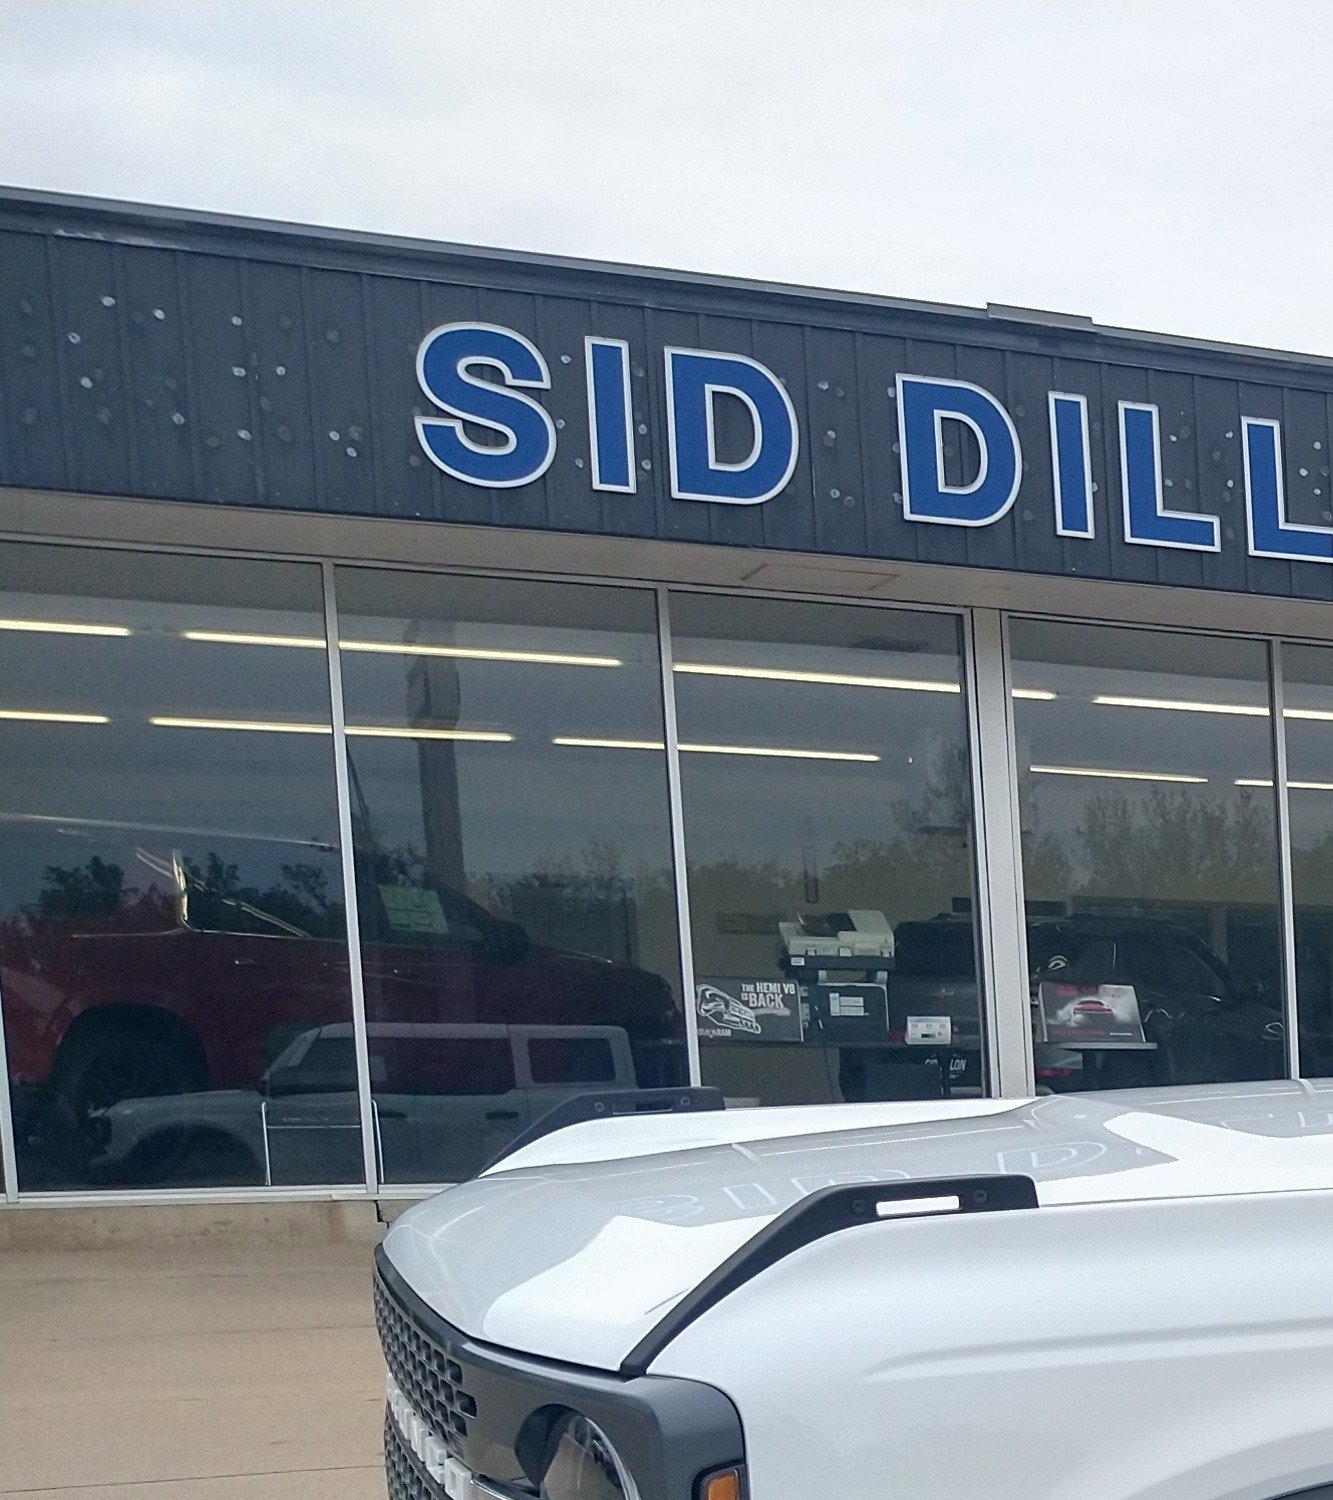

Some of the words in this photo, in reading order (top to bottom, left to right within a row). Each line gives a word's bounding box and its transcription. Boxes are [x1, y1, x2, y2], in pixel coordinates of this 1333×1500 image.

[414, 321, 799, 506] SID
[755, 982, 781, 994] HEMI
[782, 983, 796, 995] V8
[748, 993, 785, 1008] BACK
